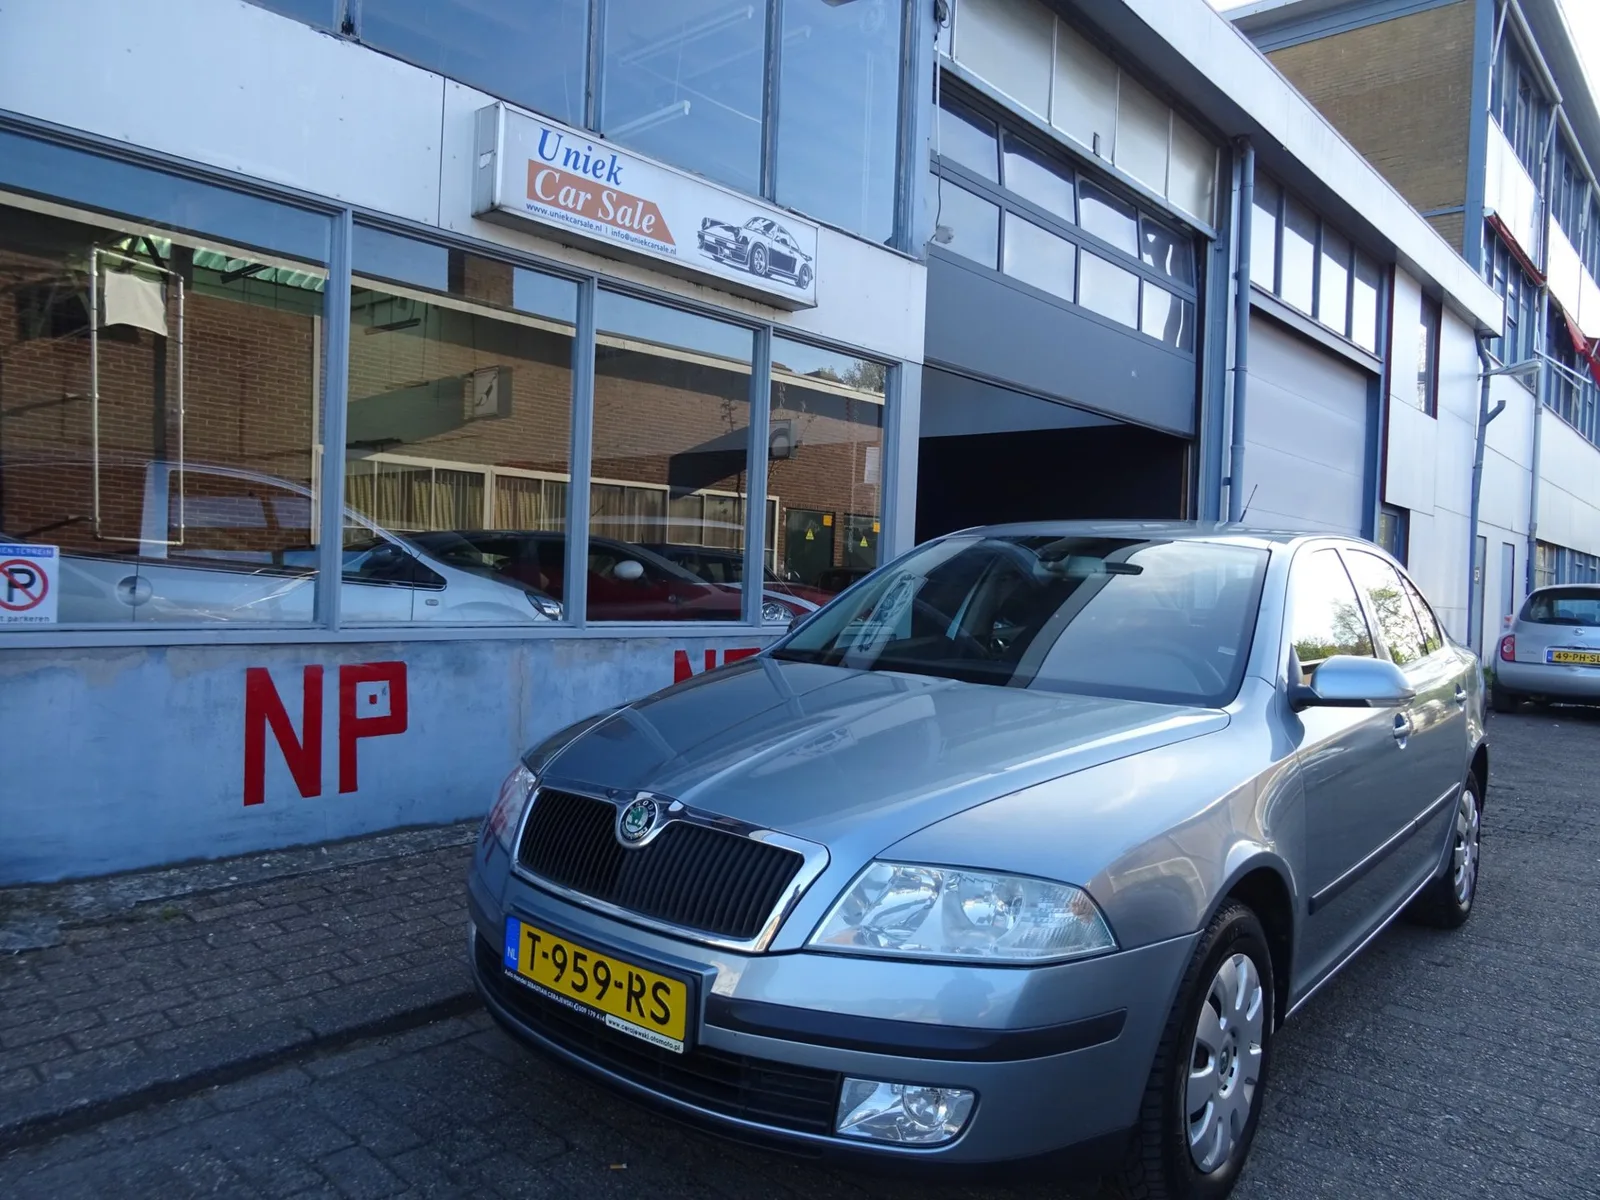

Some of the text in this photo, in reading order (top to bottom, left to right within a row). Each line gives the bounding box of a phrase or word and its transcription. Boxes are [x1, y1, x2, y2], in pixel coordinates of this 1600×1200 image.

[538, 127, 624, 186] Uniek
[526, 202, 677, 256] www.uniekcarsale.nl info@uniekcarsale.nl
[534, 169, 656, 234] Car Sale
[243, 661, 408, 806] NP
[507, 945, 518, 961] NL
[527, 931, 671, 1026] T-959-RS
